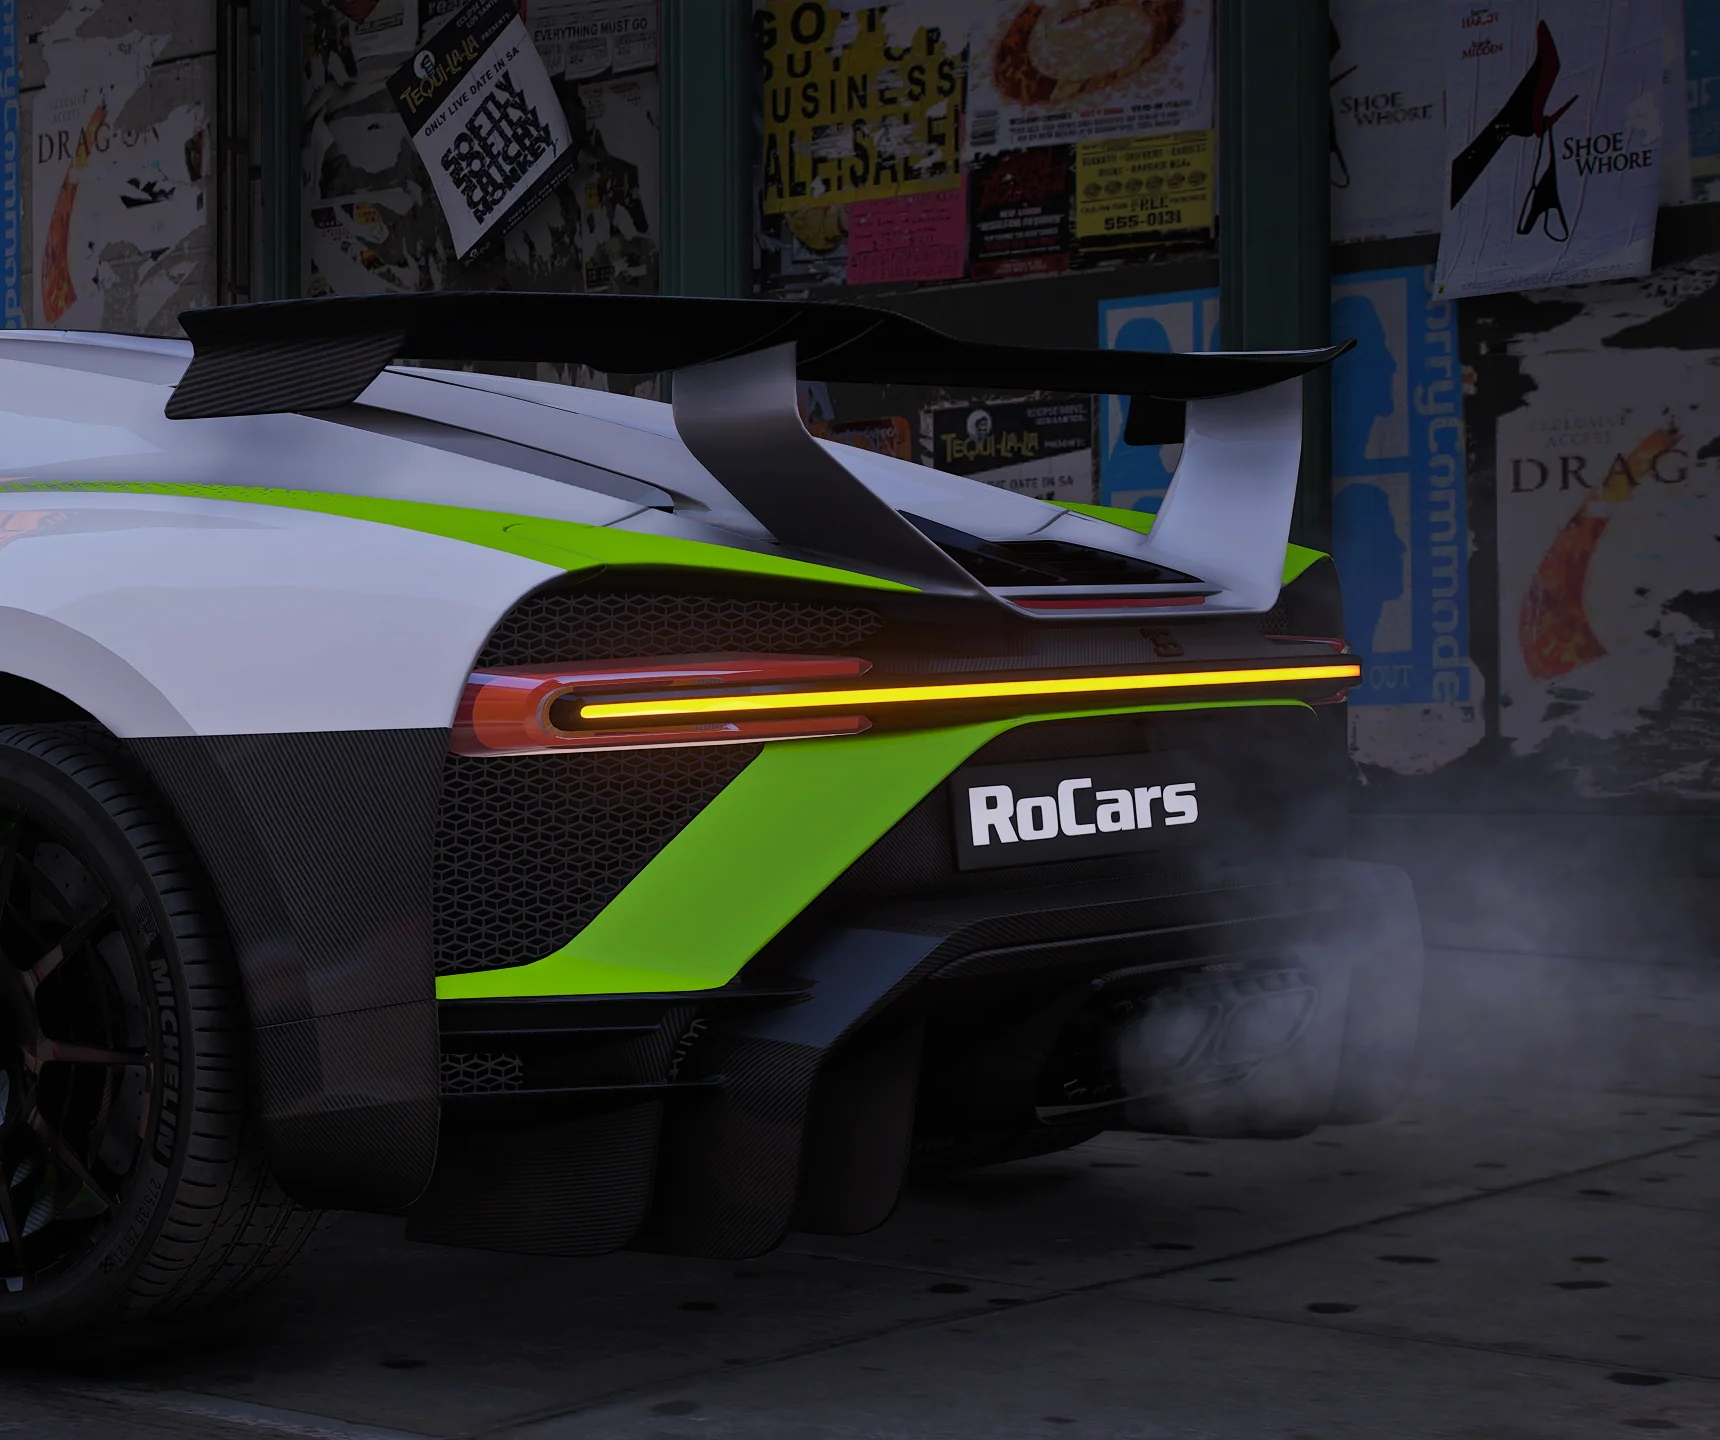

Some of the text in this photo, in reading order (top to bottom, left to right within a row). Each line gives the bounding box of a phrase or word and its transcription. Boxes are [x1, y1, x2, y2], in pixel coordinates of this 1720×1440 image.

[534, 17, 648, 43] EVERYTHING MUST GO
[424, 112, 447, 137] ONLY
[448, 91, 470, 115] LIVE
[470, 71, 493, 95] DATE
[494, 59, 506, 73] IN
[507, 47, 520, 61] SA
[770, 58, 955, 123] USINESS
[1339, 91, 1403, 115] SHOE
[1354, 104, 1434, 126] WHORE
[1562, 132, 1623, 160] SHOE
[0, 0, 23, 329] orryCommod
[1576, 149, 1652, 177] WHORE
[939, 429, 1040, 465] TEQUI-LA-LA
[1010, 477, 1039, 491] DATE
[1042, 476, 1056, 488] IN
[1059, 475, 1074, 487] SA
[1368, 665, 1413, 690] OUT
[968, 777, 1199, 847] RoCars
[149, 957, 180, 1168] MICHELIN
